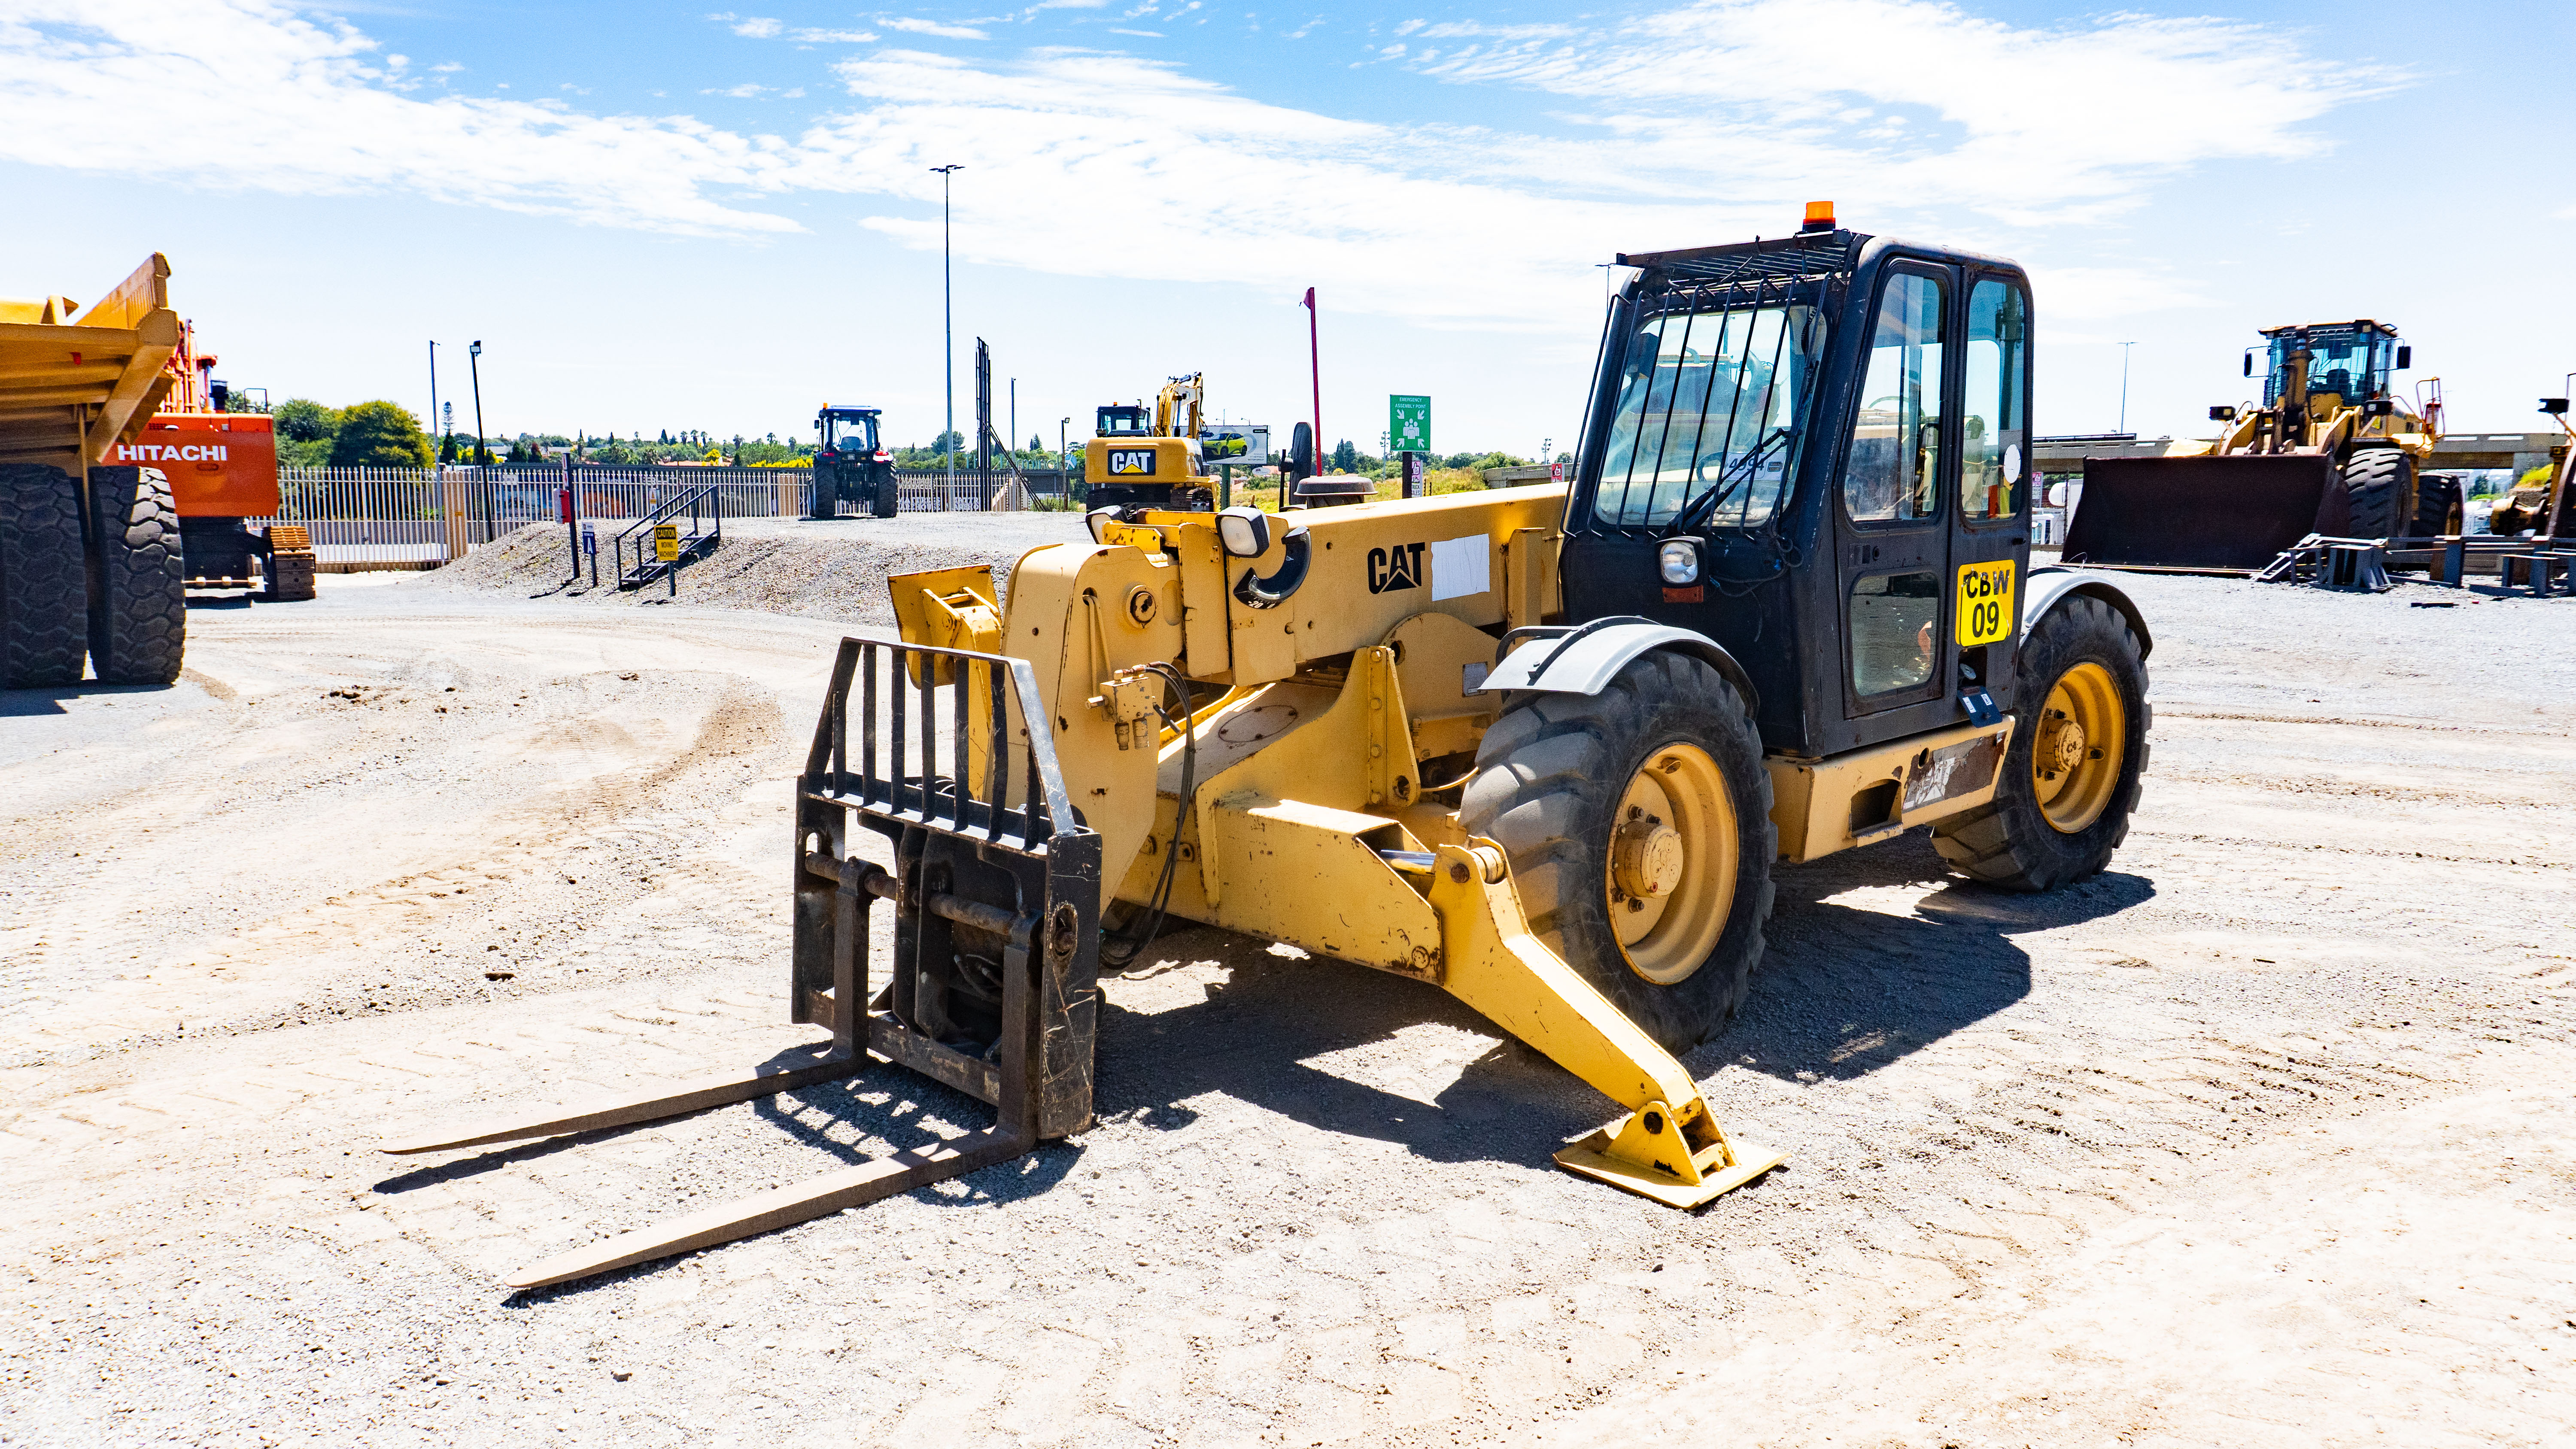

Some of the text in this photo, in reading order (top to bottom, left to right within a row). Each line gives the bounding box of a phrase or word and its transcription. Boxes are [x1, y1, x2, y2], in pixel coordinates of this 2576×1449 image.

[117, 445, 227, 461] HITACHI
[1112, 452, 1150, 473] CAT
[657, 529, 675, 537] CAUTION
[587, 537, 593, 553] A
[1367, 542, 1425, 594] CAT
[1966, 569, 2010, 599] CBW
[1972, 601, 1999, 638] 09
